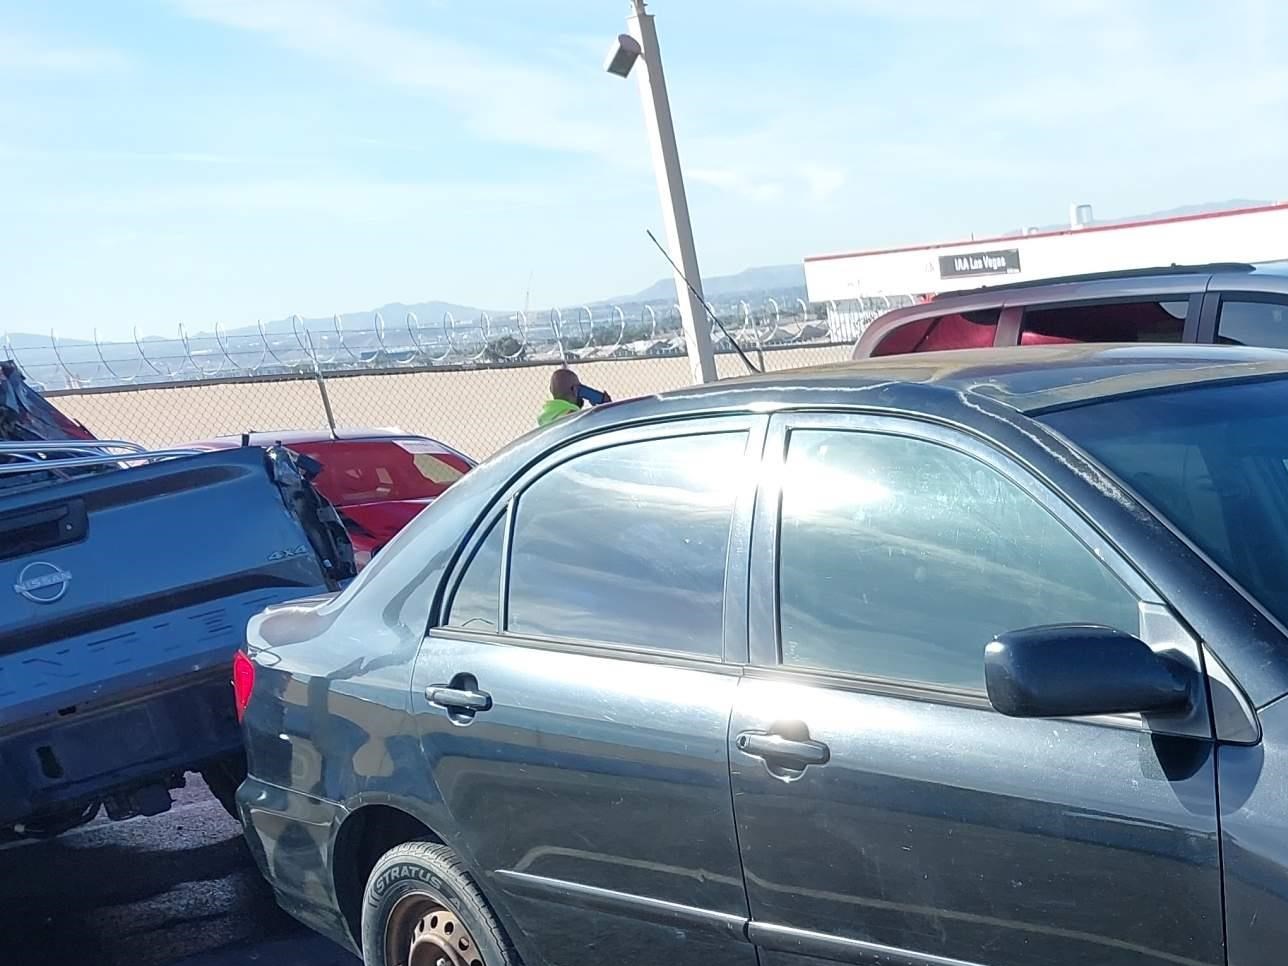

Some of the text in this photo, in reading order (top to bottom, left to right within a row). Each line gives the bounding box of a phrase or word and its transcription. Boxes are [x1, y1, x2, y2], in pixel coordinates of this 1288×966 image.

[970, 256, 983, 270] Las
[983, 255, 1006, 269] Vegas
[377, 866, 442, 891] STRATUS
